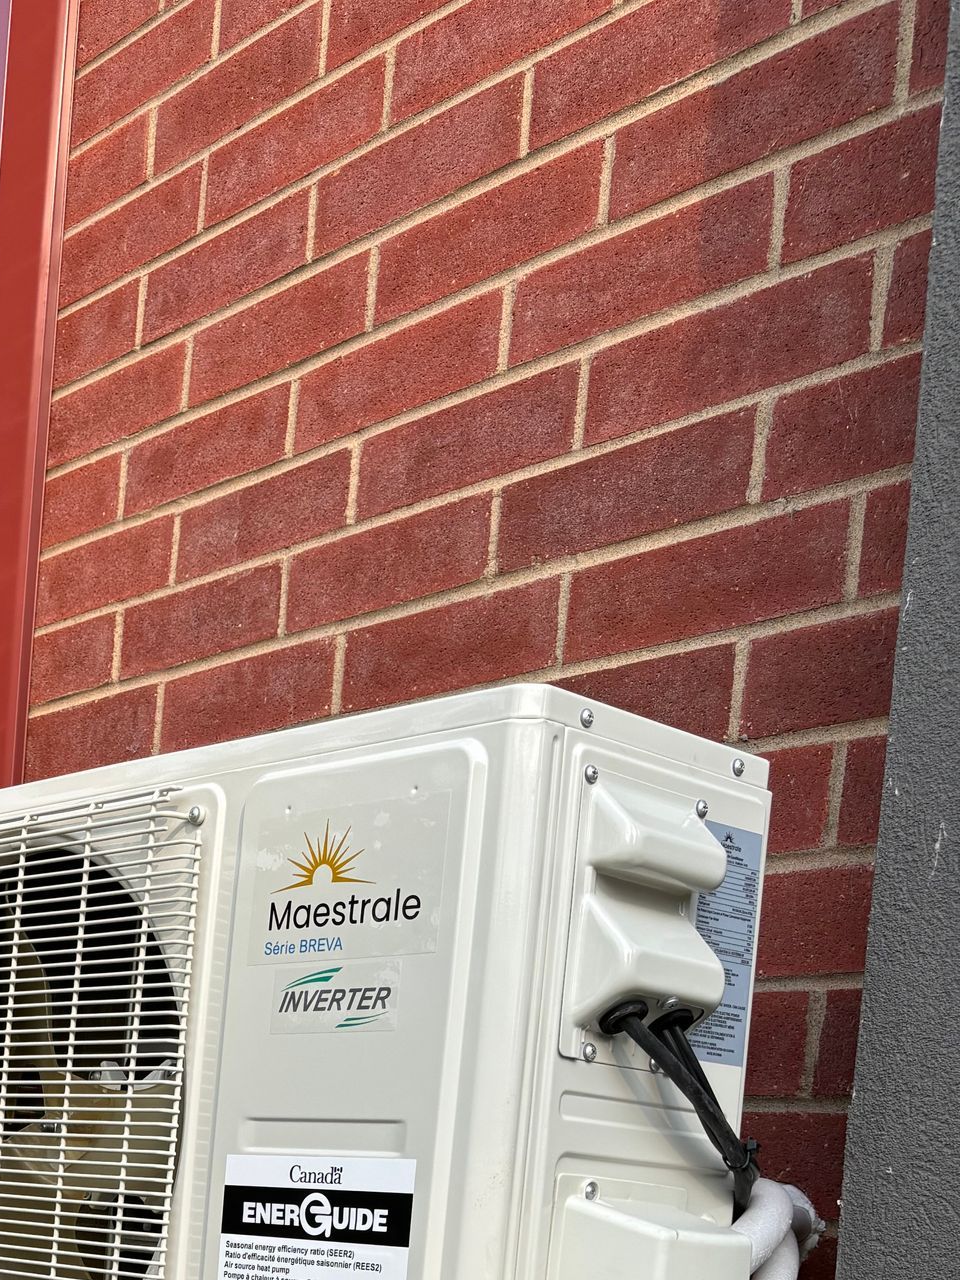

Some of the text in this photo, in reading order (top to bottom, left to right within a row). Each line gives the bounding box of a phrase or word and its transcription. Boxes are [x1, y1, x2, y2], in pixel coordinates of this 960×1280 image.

[268, 888, 421, 931] Maestrale
[264, 937, 343, 956] Série BREVA
[279, 986, 391, 1013] INVERTER
[290, 1164, 343, 1185] Canada
[242, 1192, 389, 1238] ENERGUIDE
[225, 1240, 355, 1260] Seasonal energy efficiency ratio (SEER2)
[224, 1250, 382, 1274] Ratio d'efficacité énergétique saisonnier (REES2)
[224, 1260, 290, 1275] Air source heat pump
[223, 1270, 245, 1280] Pompe
[245, 1272, 251, 1280] à
